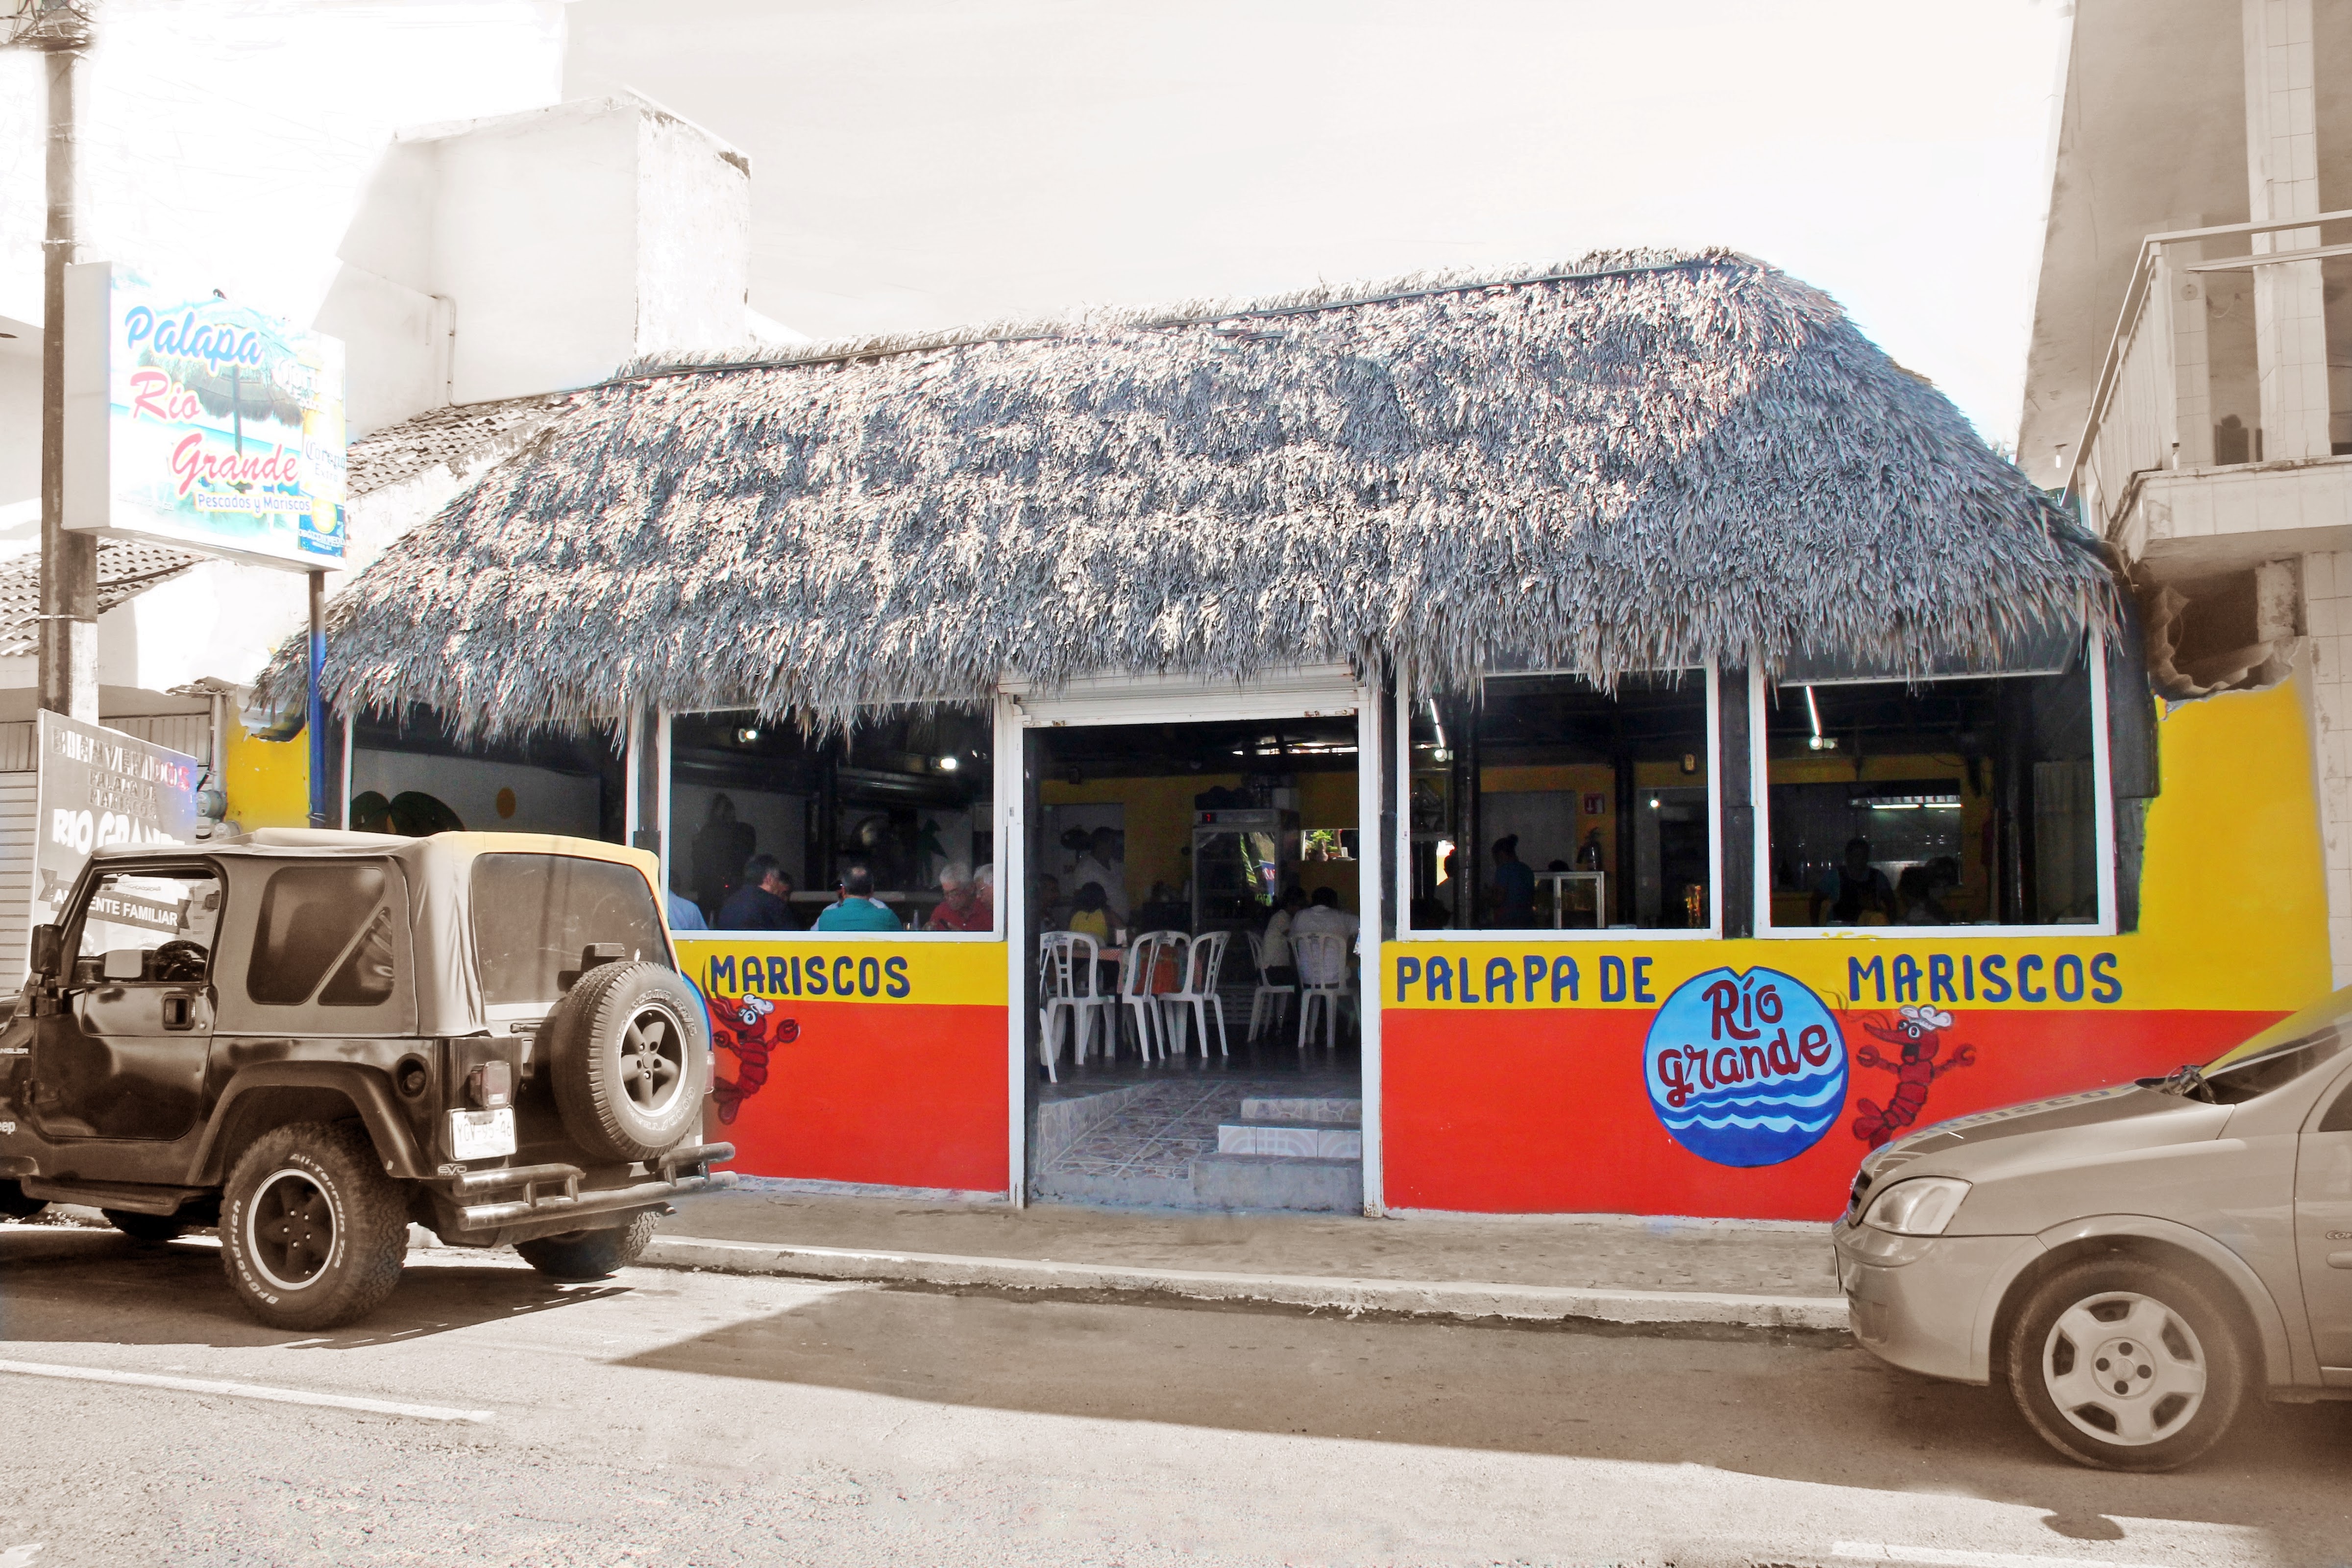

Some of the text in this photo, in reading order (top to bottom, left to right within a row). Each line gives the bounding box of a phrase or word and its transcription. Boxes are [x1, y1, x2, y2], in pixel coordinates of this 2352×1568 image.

[126, 306, 263, 370] Palapa
[130, 371, 200, 419] Rio
[172, 434, 298, 495] Grande
[198, 493, 311, 514] Pescados y Mariscos
[51, 726, 190, 792] BIENVENIDOS
[52, 808, 94, 855] RIO
[53, 888, 179, 927] AENTE FAMILIAR
[712, 956, 910, 999] MARISCOS
[1396, 956, 1656, 1004] PALAPA DE
[1848, 953, 2123, 1004] MARISCOS
[1701, 977, 1784, 1041] Río
[1658, 1024, 1833, 1107] grande
[438, 1164, 467, 1176] EVO
[230, 1200, 279, 1305] BFGoodrich
